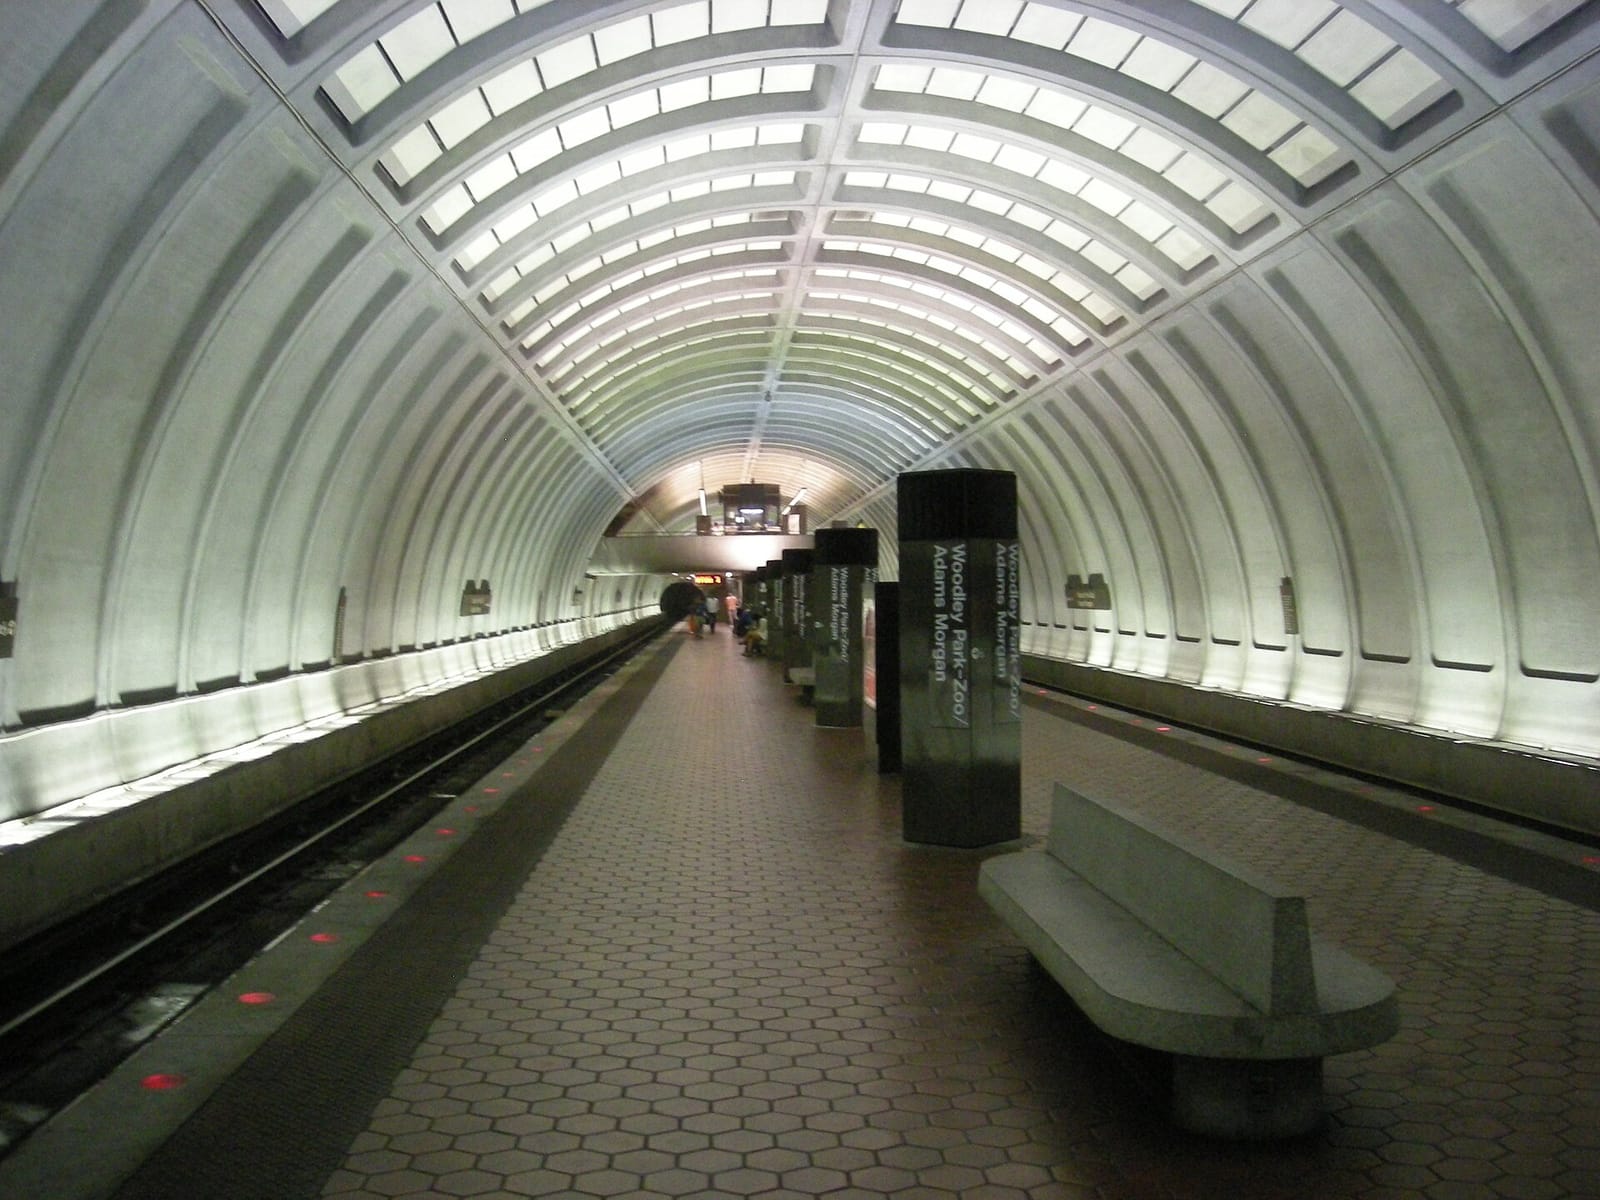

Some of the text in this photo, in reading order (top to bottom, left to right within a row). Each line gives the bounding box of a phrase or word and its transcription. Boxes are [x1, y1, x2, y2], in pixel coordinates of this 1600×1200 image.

[830, 603, 840, 640] Morgan
[932, 544, 948, 682] Adams Morgan
[950, 544, 970, 726] Woodley Park-Zoo/
[994, 543, 1007, 678] Adams Morgan
[1007, 543, 1019, 619] Woodley
